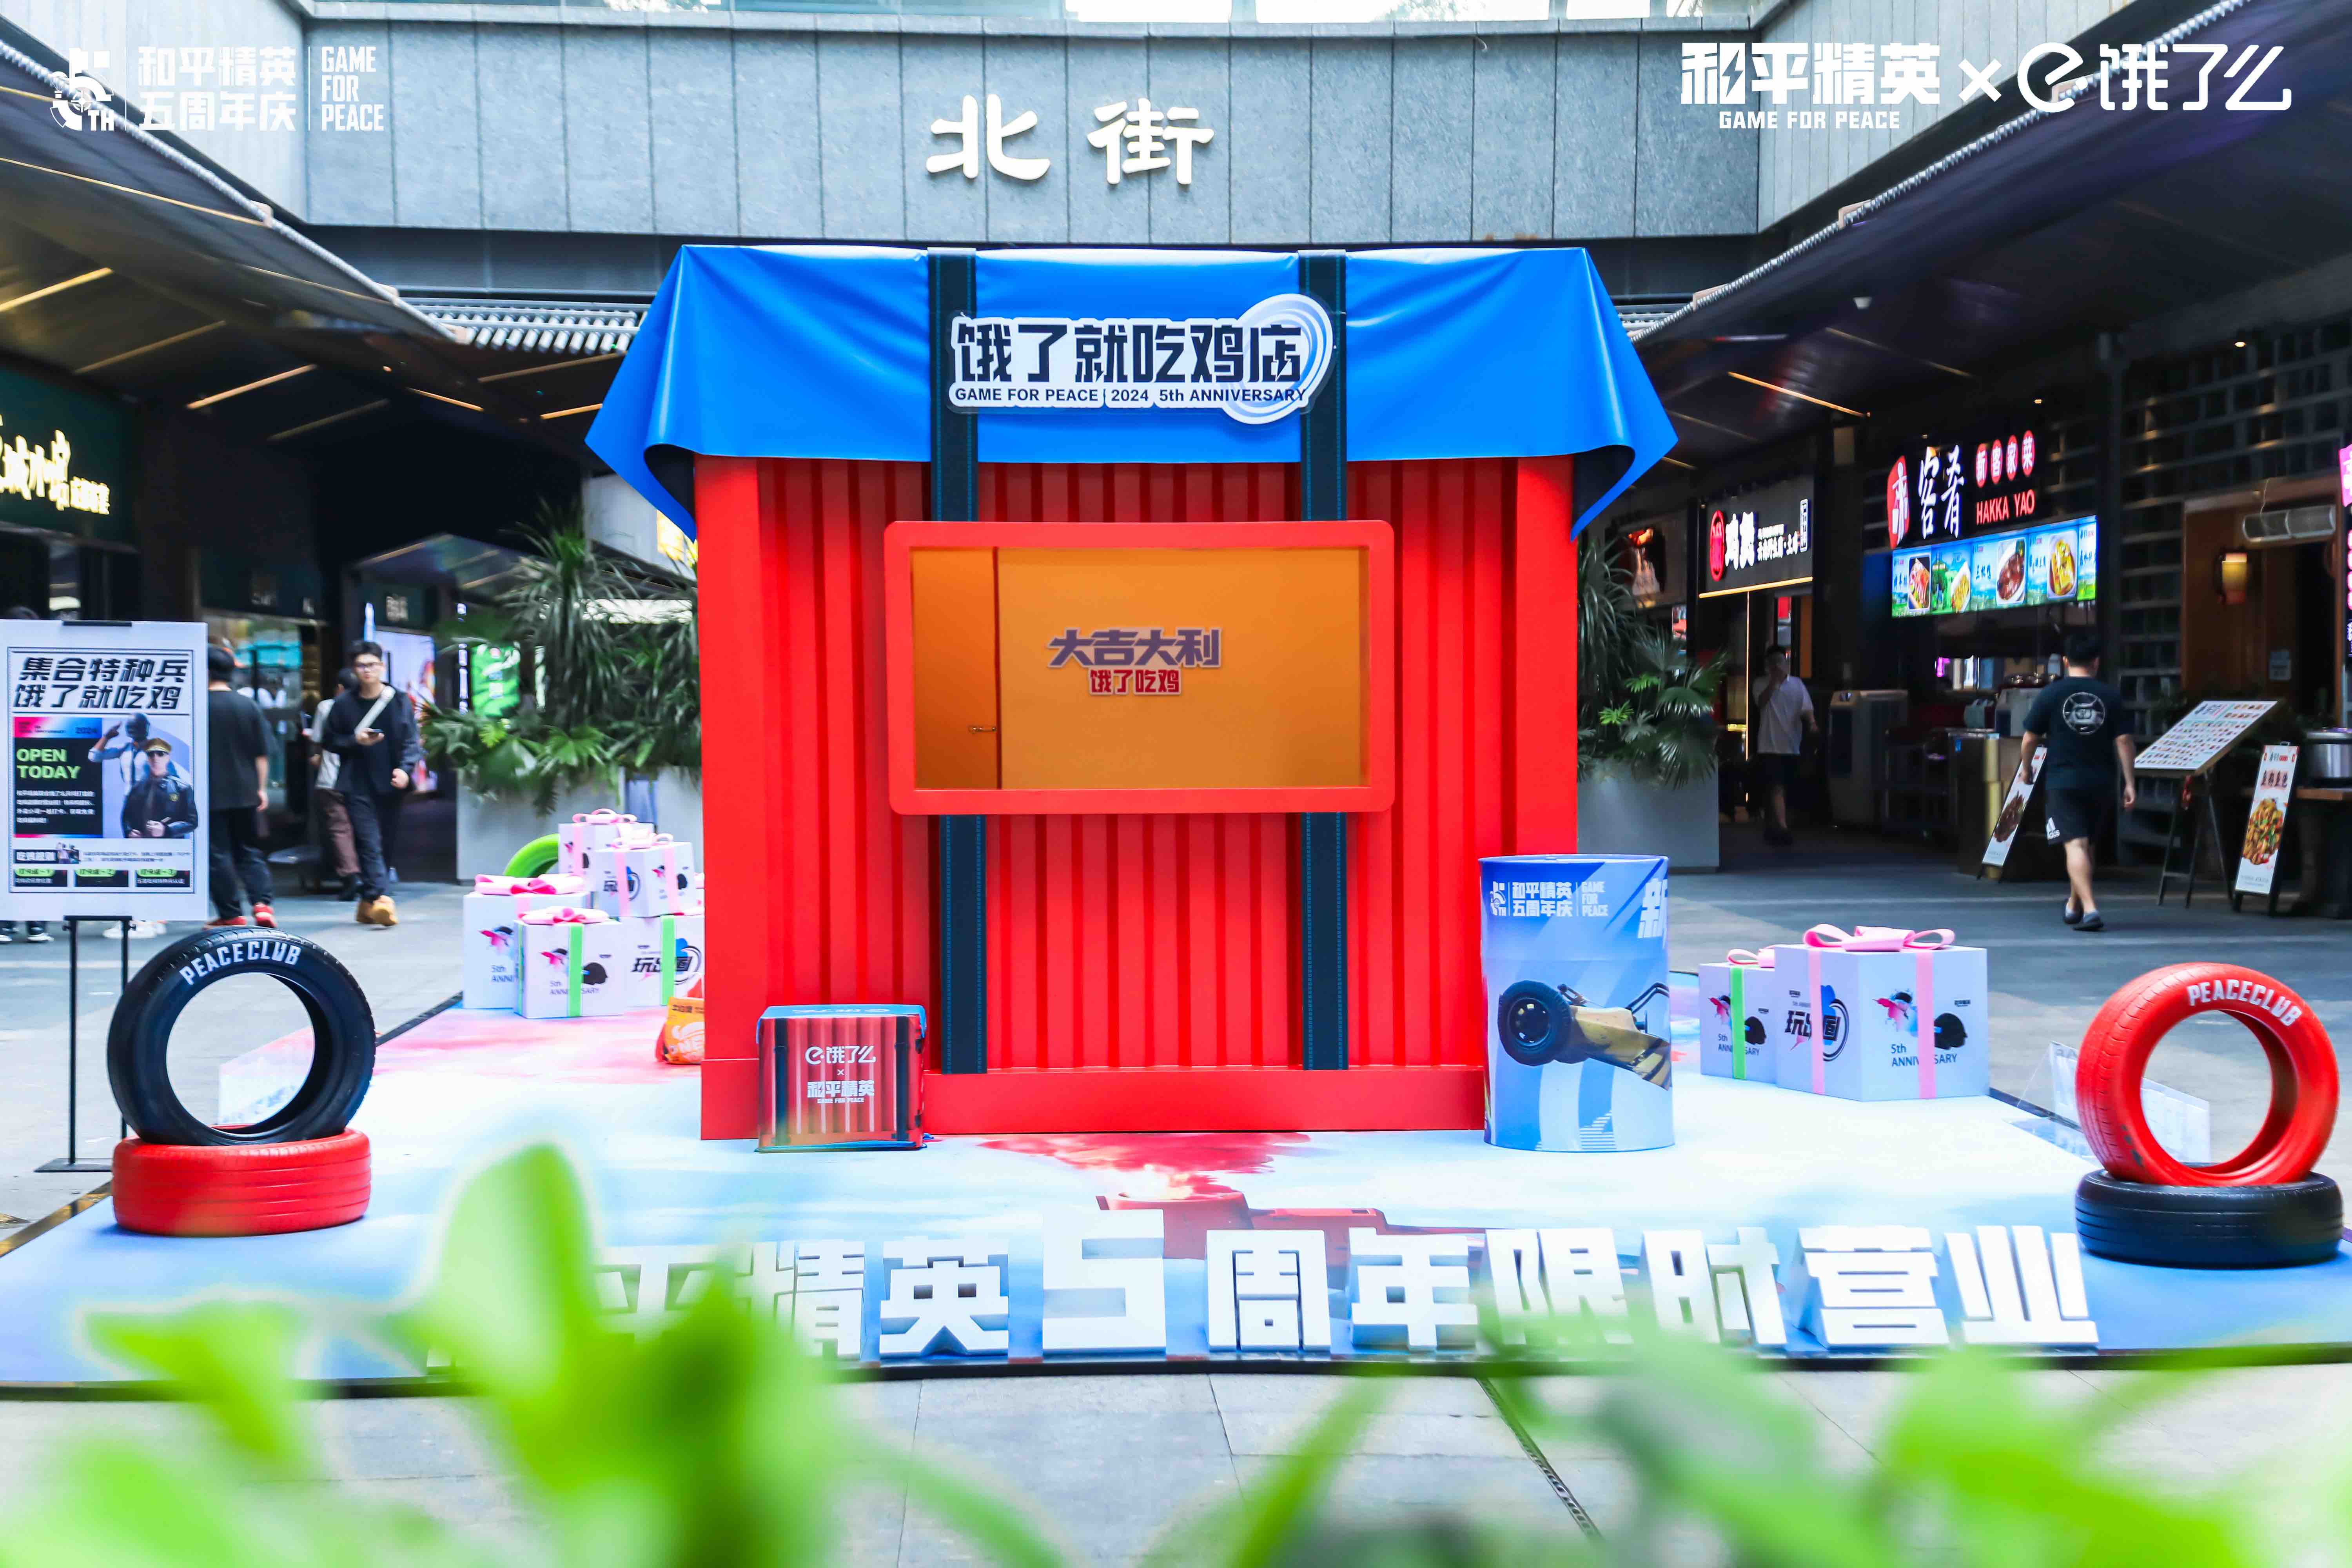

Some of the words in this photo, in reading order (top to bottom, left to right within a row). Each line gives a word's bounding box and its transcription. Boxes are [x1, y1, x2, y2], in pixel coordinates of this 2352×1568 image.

[926, 94, 1214, 185] 北街
[957, 323, 1301, 383] 饿了就吃鸡店
[955, 388, 1002, 401] GAME
[1008, 388, 1040, 401] FOR
[1045, 388, 1099, 401] PEACE
[1111, 388, 1149, 401] 2024
[1160, 388, 1184, 401] 5th
[1190, 389, 1307, 401] ANNIVERSARY
[1975, 435, 2034, 483] 新客家菜
[1976, 496, 2009, 525] HAKKA
[2014, 490, 2035, 517] YAO
[1050, 629, 1220, 666] 大吉大利
[19, 657, 189, 683] 集合特种兵
[1090, 669, 1179, 693] 饿了吃鸡
[13, 685, 182, 710] 饿了就吃鸡
[16, 749, 67, 762] OPEN
[16, 766, 81, 779] TODAY
[1512, 882, 1572, 899] 和平精英
[1582, 881, 1605, 893] GAME
[1582, 893, 1598, 904] FOR
[1513, 900, 1572, 916] 五周年庆
[1582, 905, 1608, 916] PEACE
[826, 1045, 876, 1063] 饿了么
[1891, 1044, 1906, 1053] 5th
[807, 1080, 875, 1098] 和平精英
